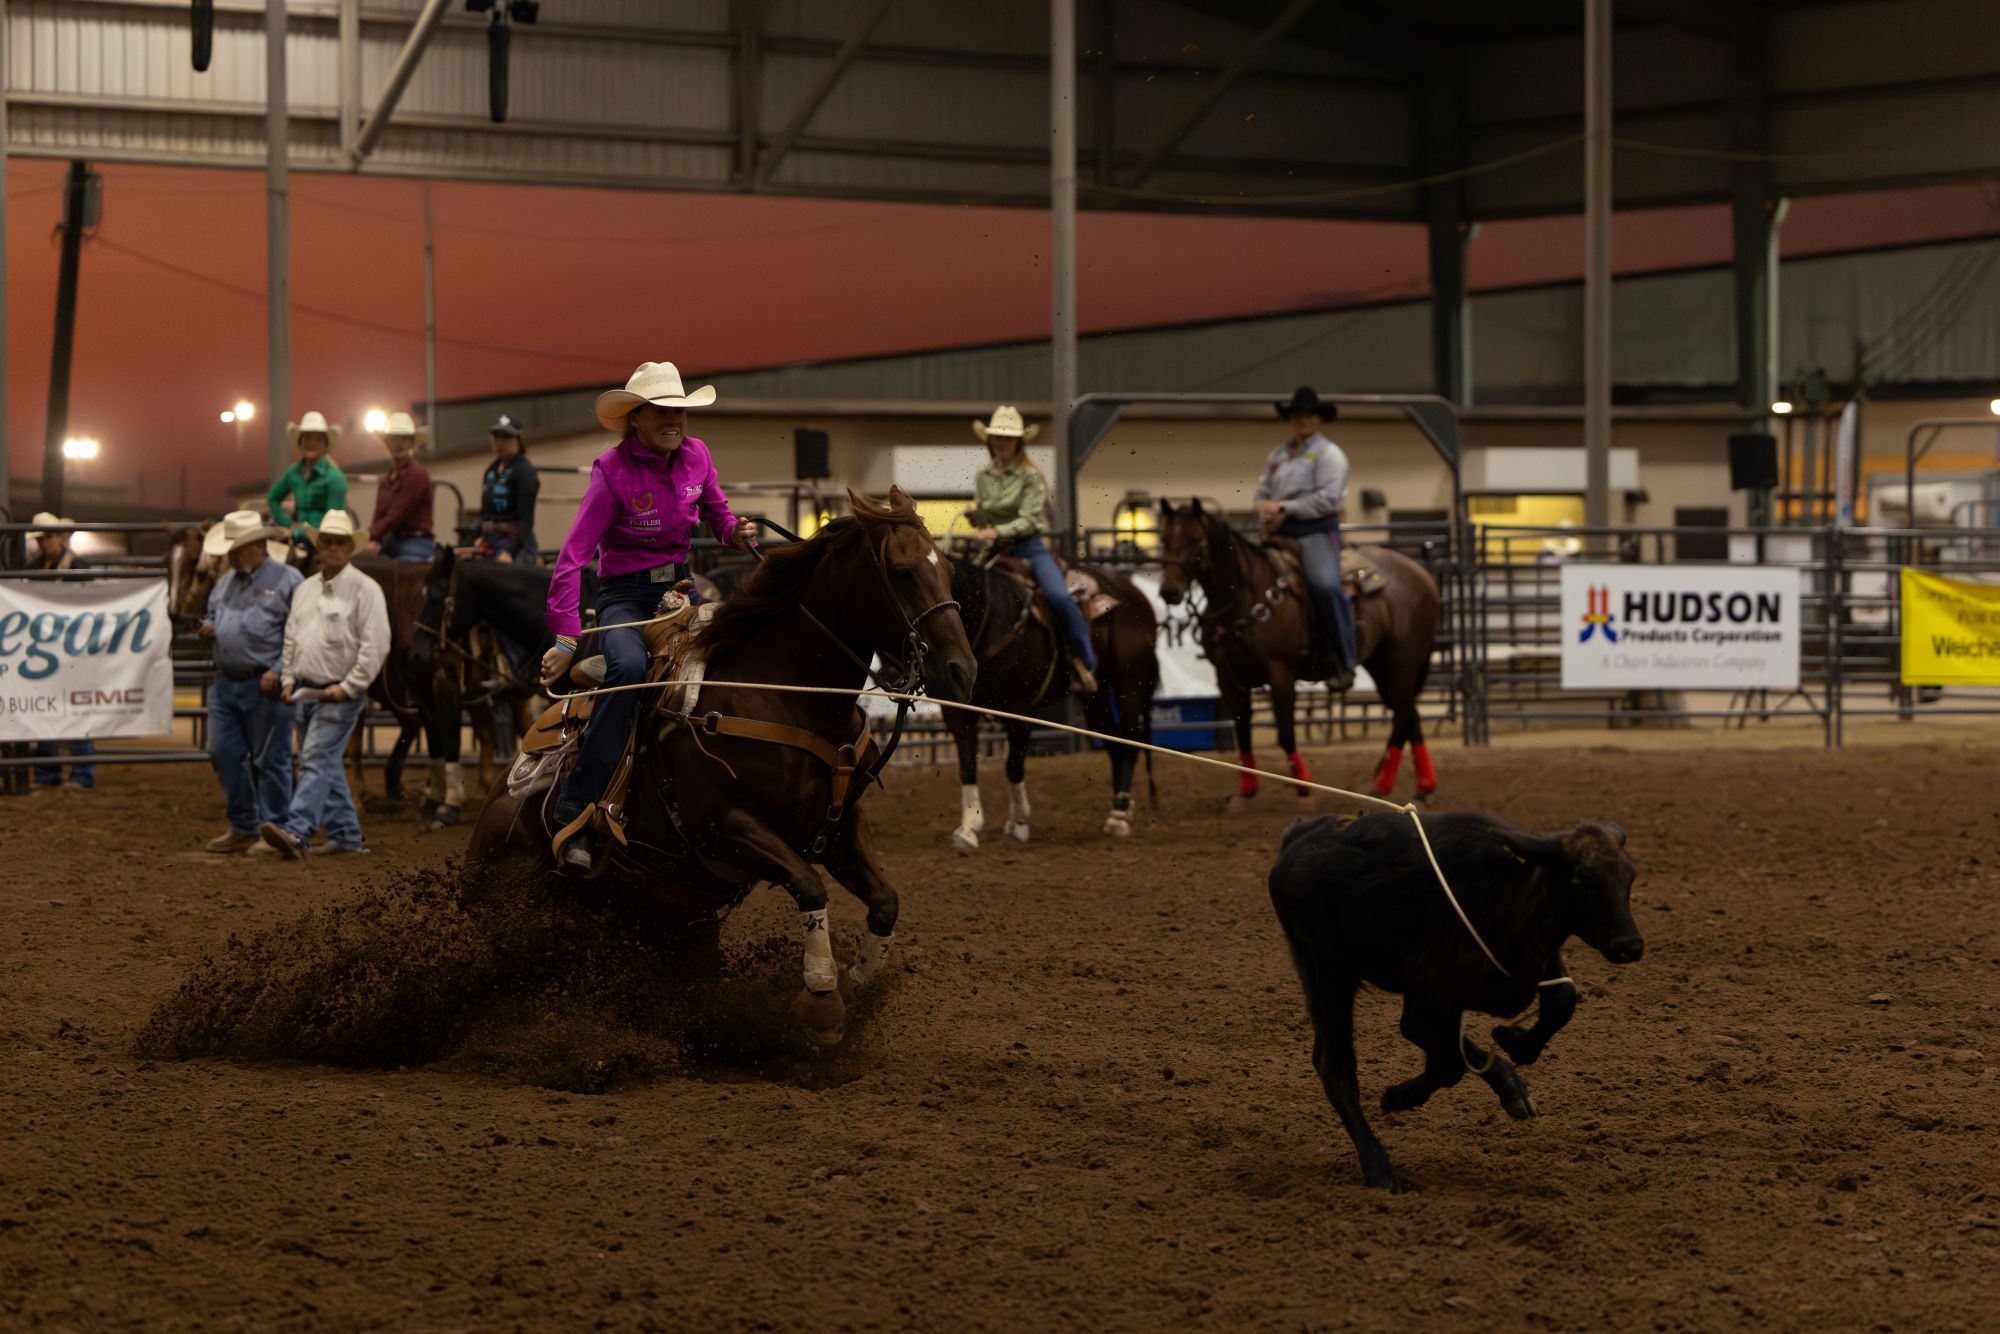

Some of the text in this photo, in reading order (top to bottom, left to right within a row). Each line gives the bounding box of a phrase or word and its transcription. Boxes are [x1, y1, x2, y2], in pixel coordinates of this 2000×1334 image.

[1623, 591, 1781, 623] HUDSON
[1622, 628, 1782, 645] Products Corporation
[1713, 653, 1767, 673] Company
[9, 695, 58, 713] BUICK
[70, 688, 145, 705] GMC
